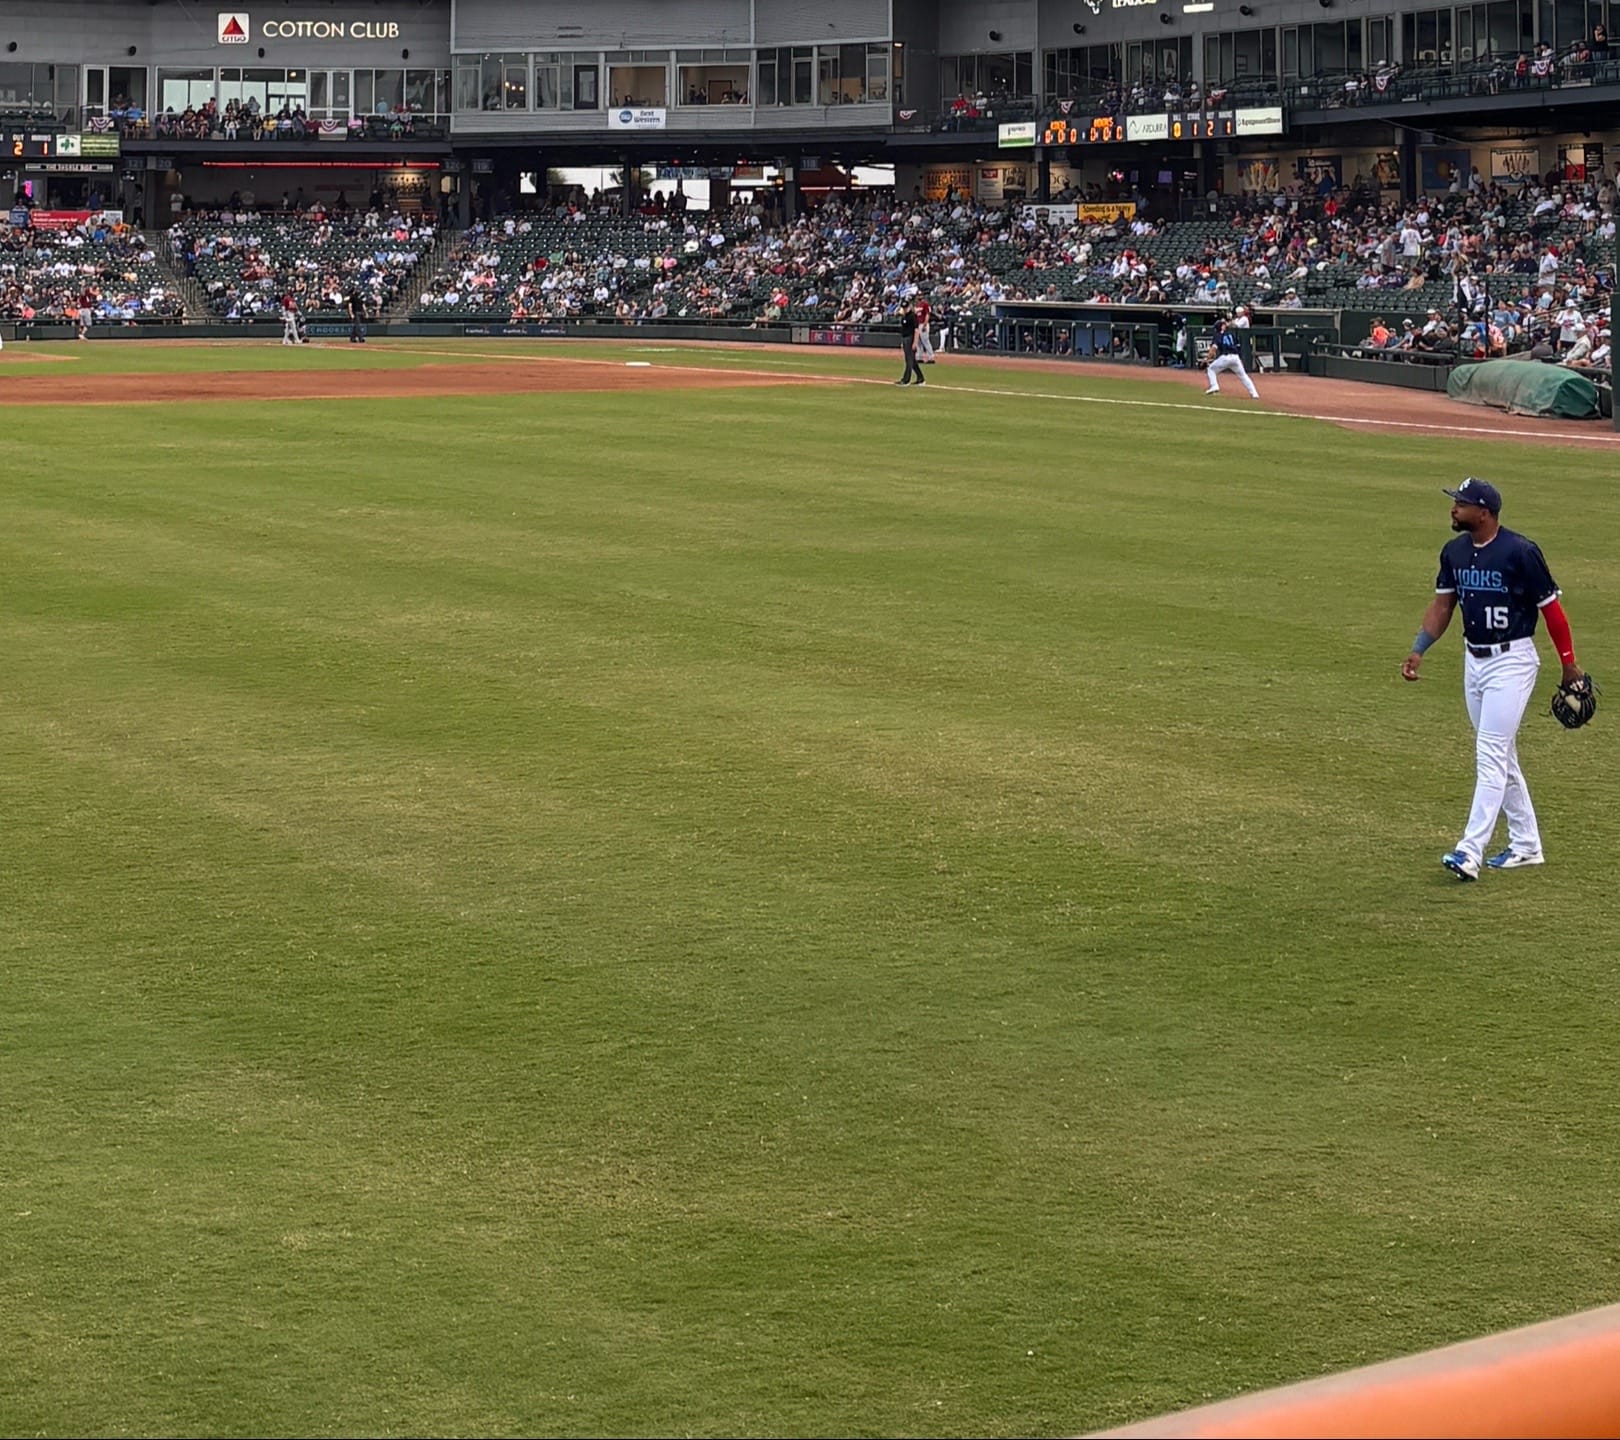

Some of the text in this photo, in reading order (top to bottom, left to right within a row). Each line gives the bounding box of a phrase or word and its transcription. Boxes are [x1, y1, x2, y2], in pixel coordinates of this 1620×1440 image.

[262, 20, 400, 38] COTTON CLUB
[1207, 120, 1214, 136] 2
[14, 141, 23, 156] 2
[1484, 606, 1509, 629] 15
